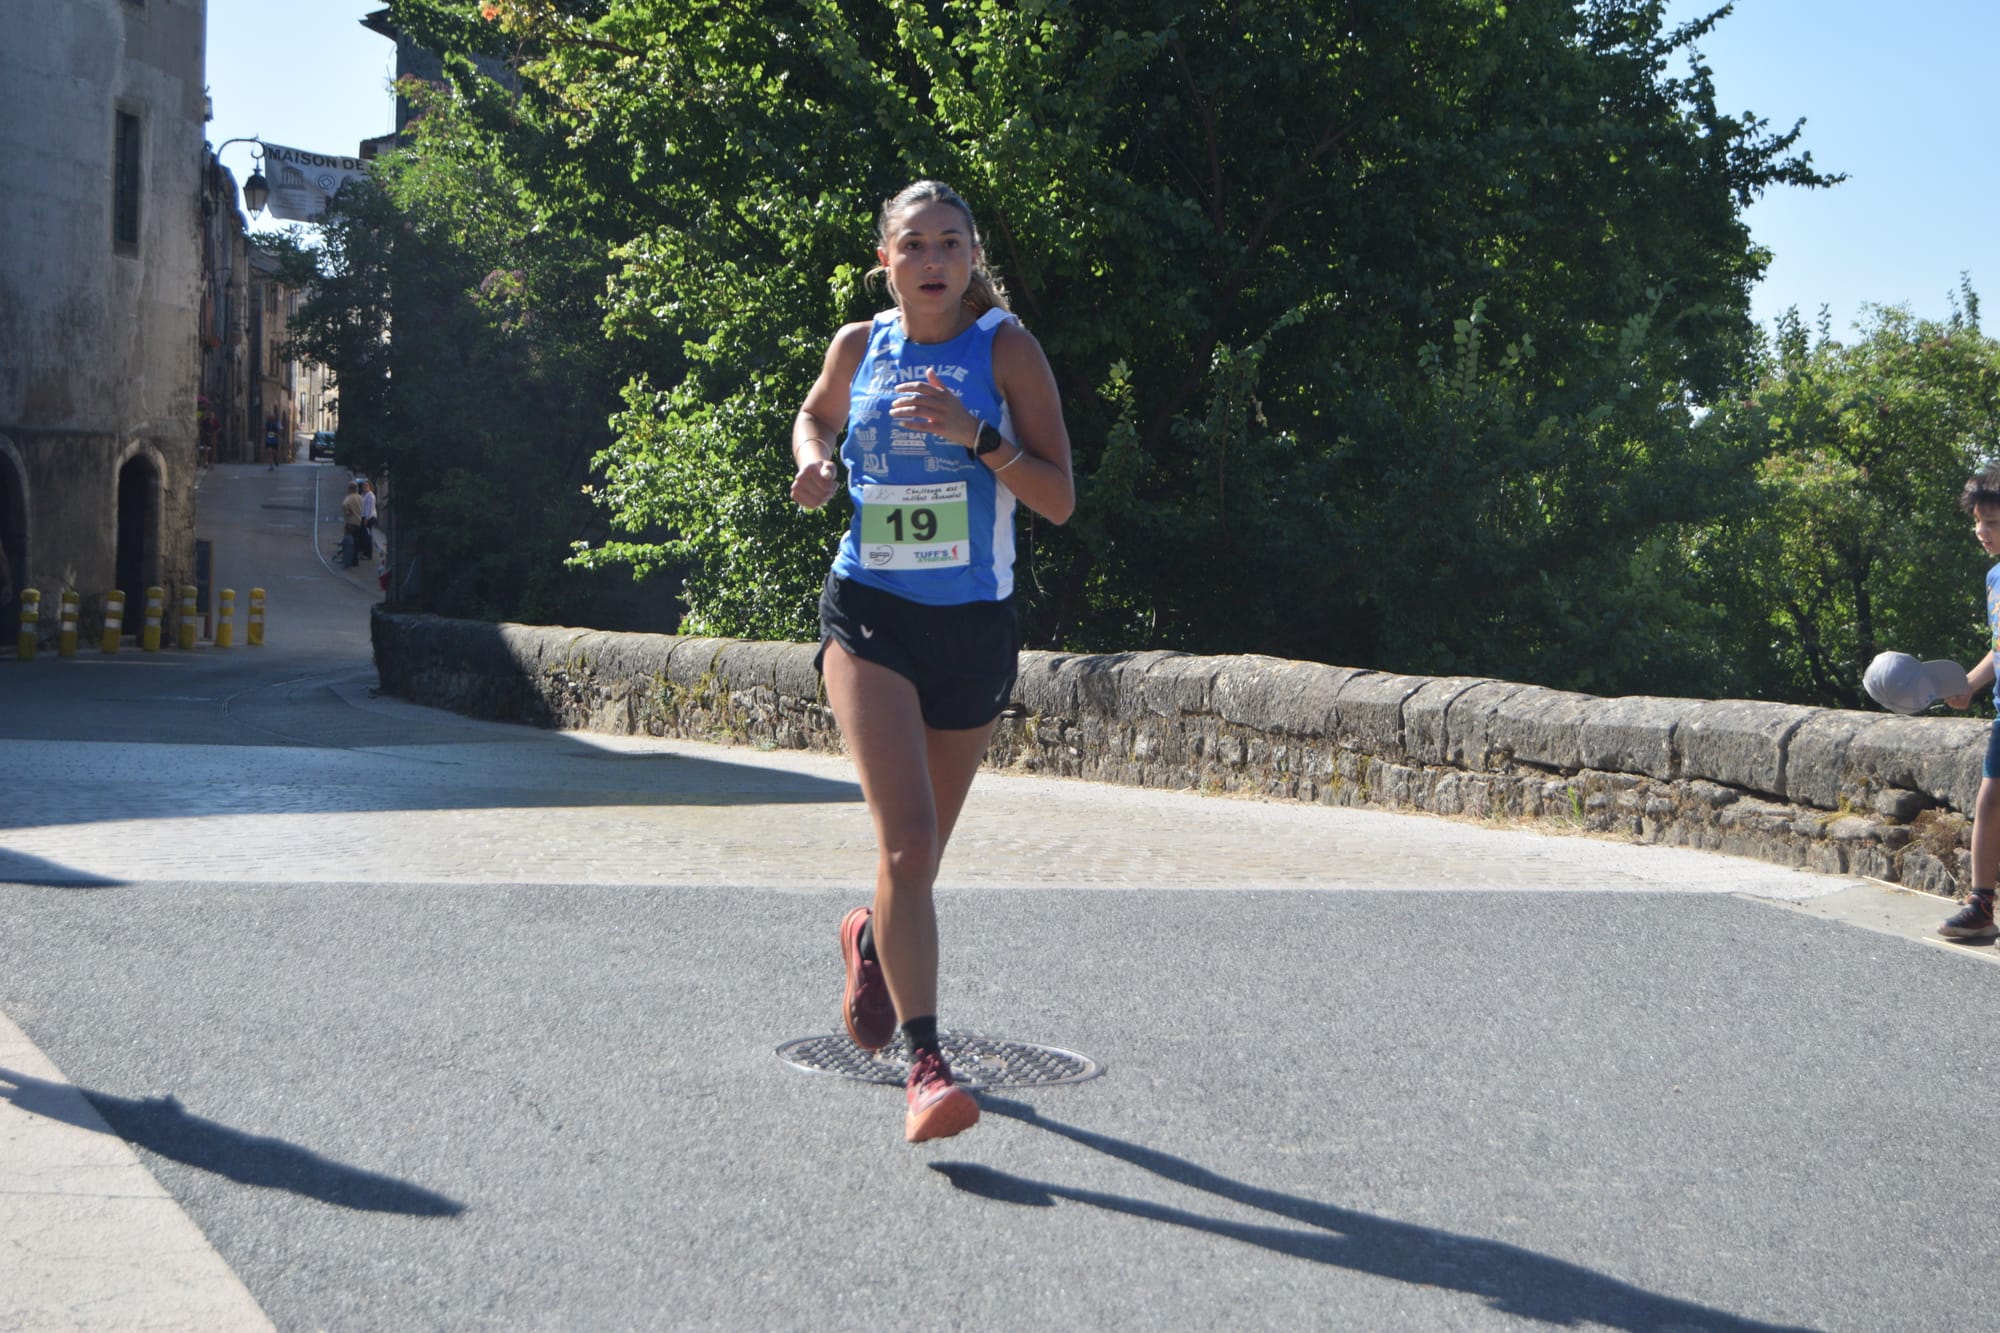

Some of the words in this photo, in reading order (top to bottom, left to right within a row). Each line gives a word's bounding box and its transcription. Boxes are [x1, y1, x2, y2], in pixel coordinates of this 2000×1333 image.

[268, 147, 337, 169] MAISON
[342, 159, 365, 171] DE
[886, 508, 938, 542] 19
